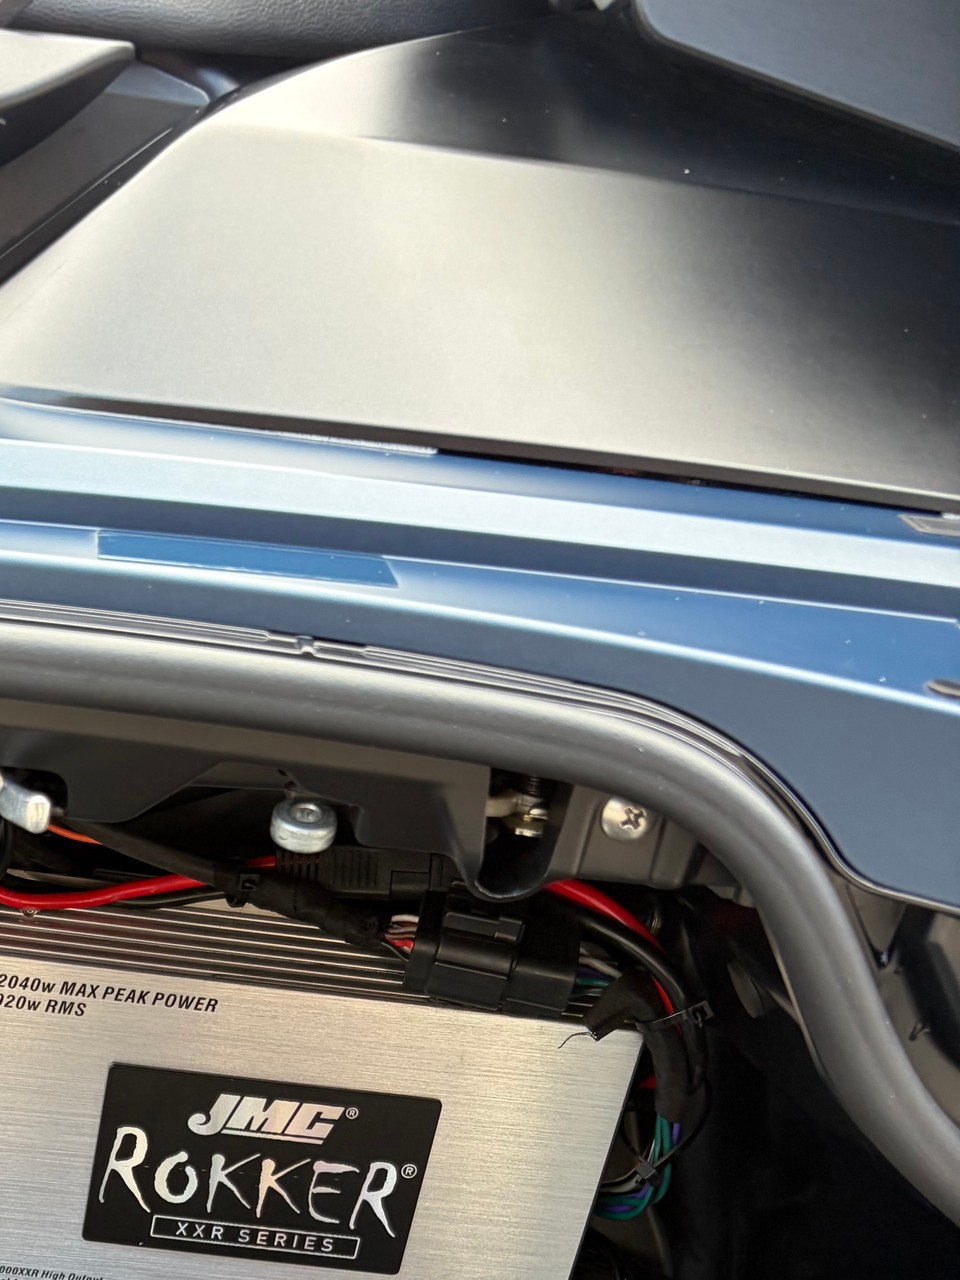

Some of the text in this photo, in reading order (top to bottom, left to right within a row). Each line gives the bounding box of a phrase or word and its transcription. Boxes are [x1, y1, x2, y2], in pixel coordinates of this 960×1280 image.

[45, 999, 87, 1017] RMS
[59, 981, 100, 999] MAX
[102, 986, 151, 1005] PEAK
[151, 992, 219, 1013] POWER
[176, 1222, 334, 1252] XXR SERIES
